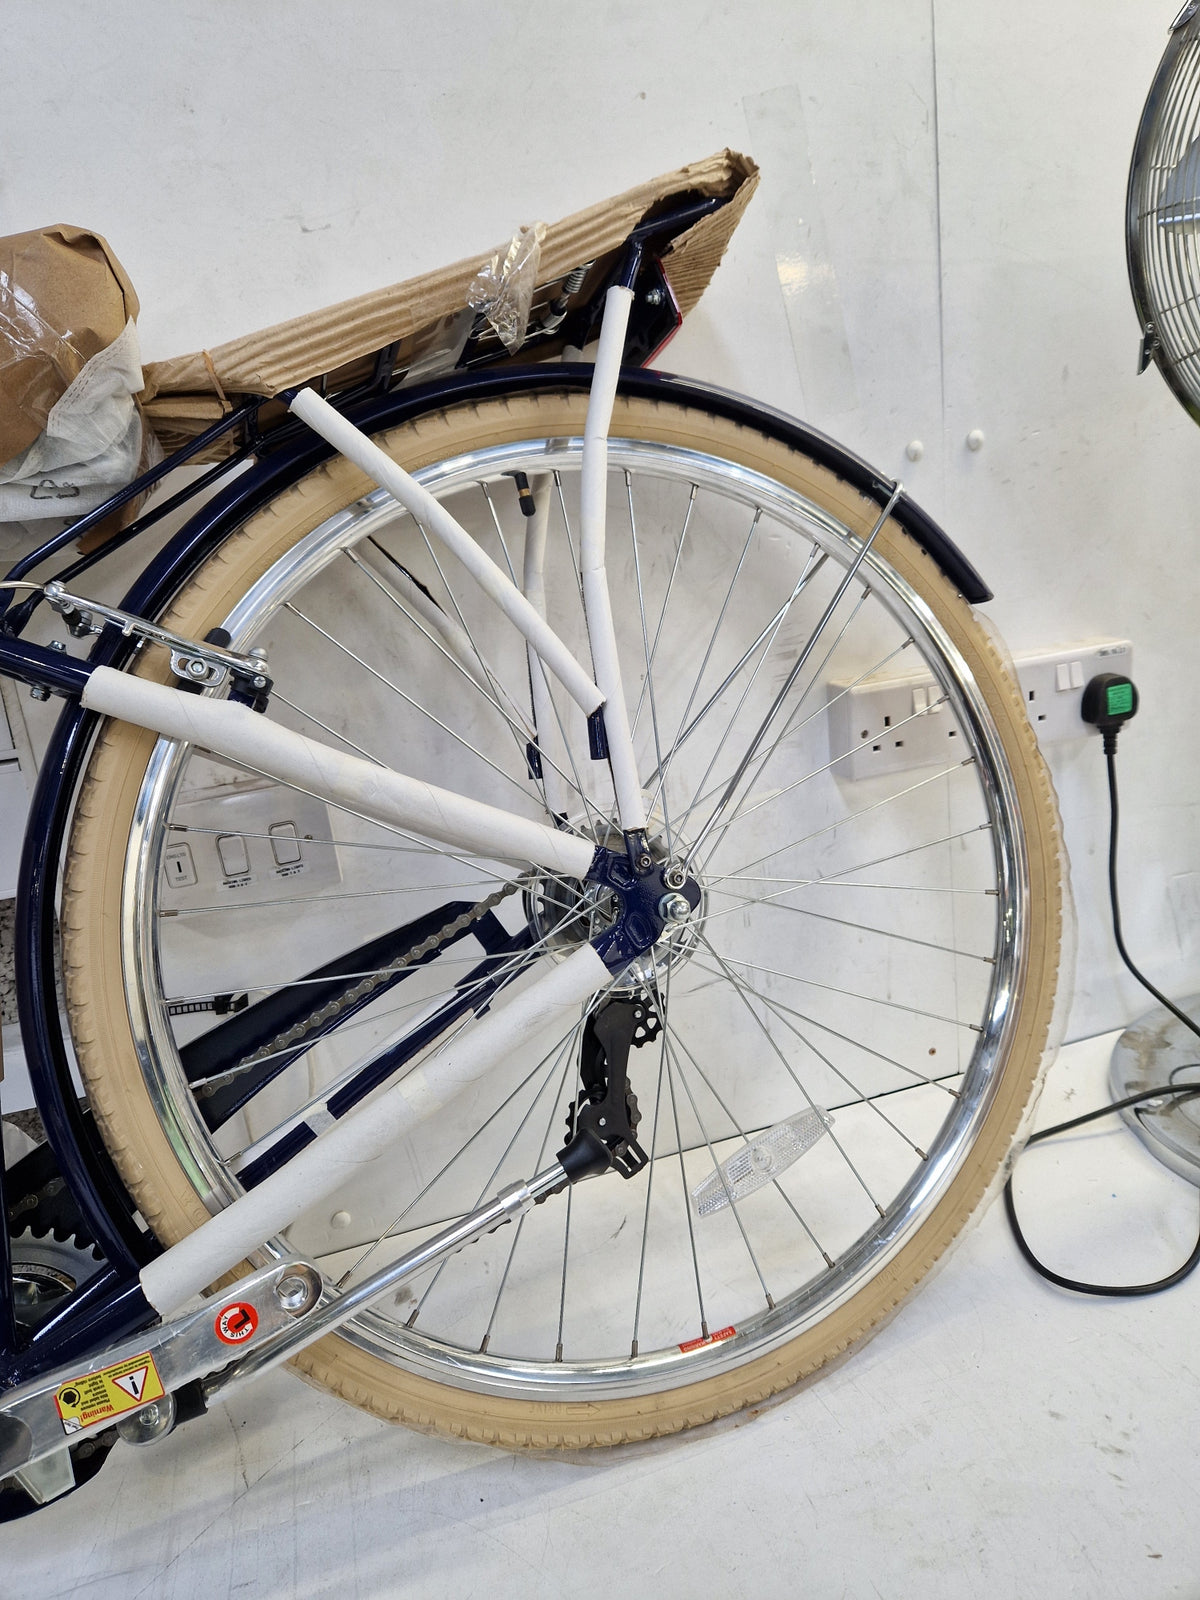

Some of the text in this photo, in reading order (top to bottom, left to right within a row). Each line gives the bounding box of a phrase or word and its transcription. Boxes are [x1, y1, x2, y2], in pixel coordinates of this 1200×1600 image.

[230, 1328, 249, 1338] THIS
[87, 1374, 101, 1382] before
[80, 1405, 113, 1422] Warning!
